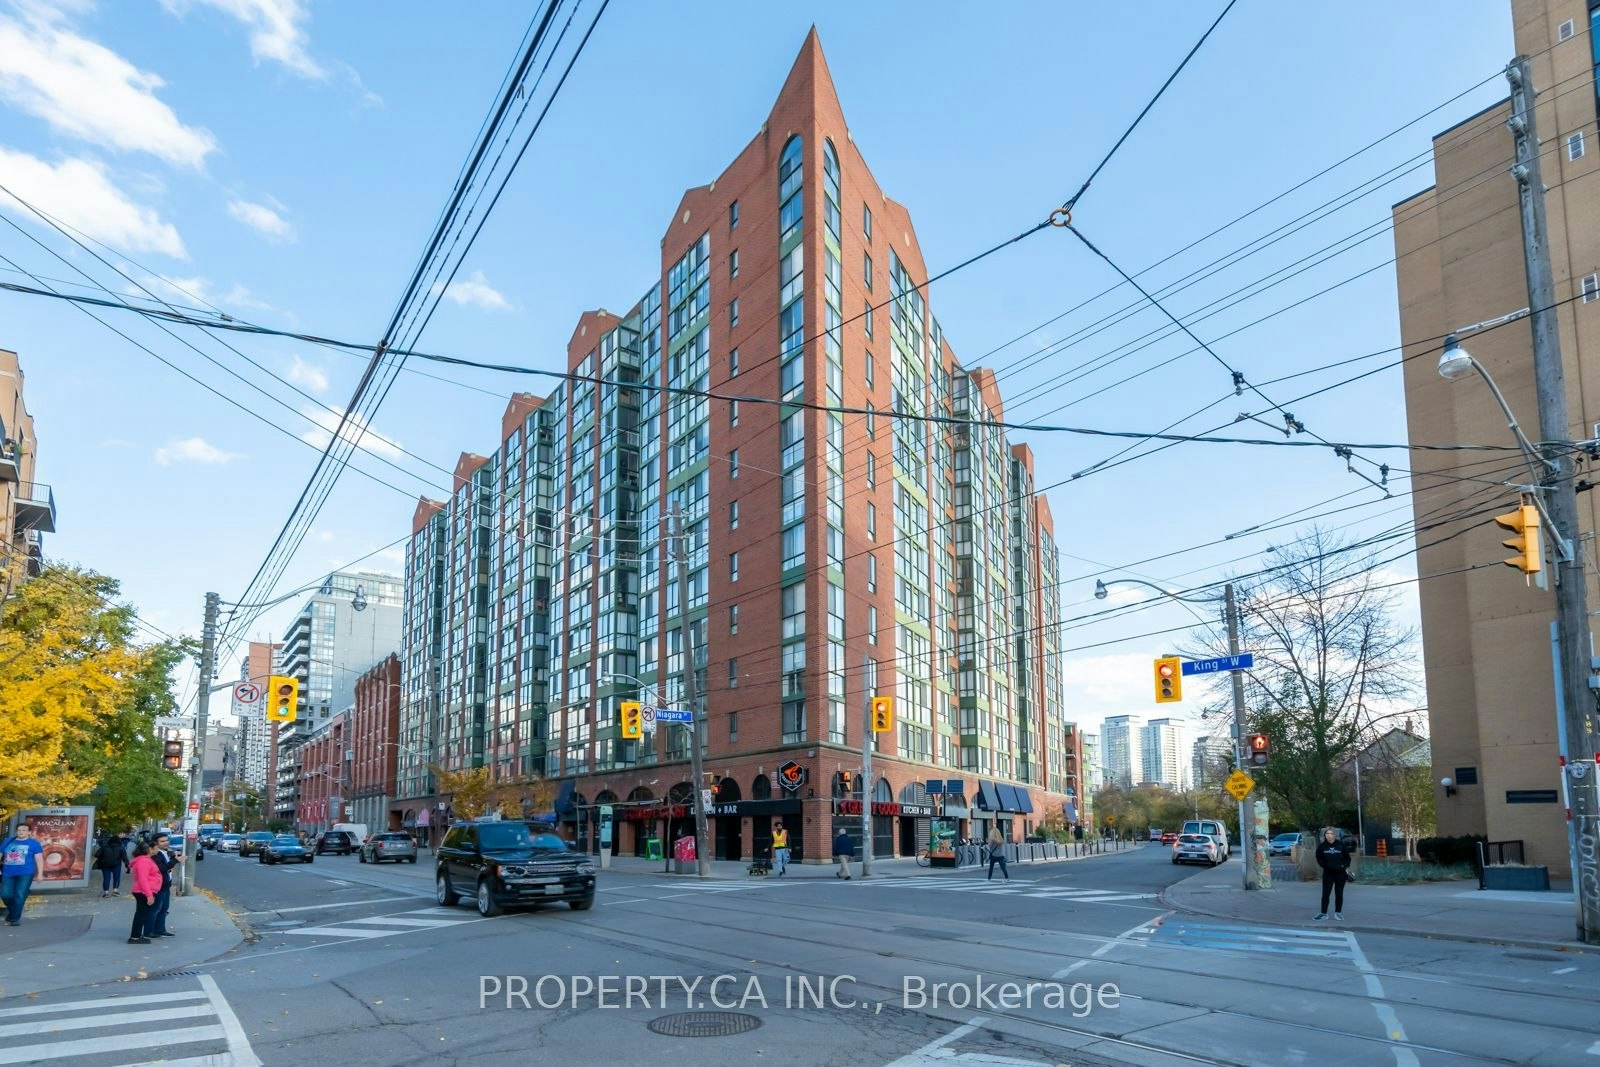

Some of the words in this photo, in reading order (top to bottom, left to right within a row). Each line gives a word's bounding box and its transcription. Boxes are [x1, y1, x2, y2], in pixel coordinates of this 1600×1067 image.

[1194, 661, 1218, 671] King
[1230, 656, 1240, 667] W
[656, 710, 683, 720] Niagara
[723, 805, 737, 814] BAR
[903, 806, 920, 814] KITCHEN
